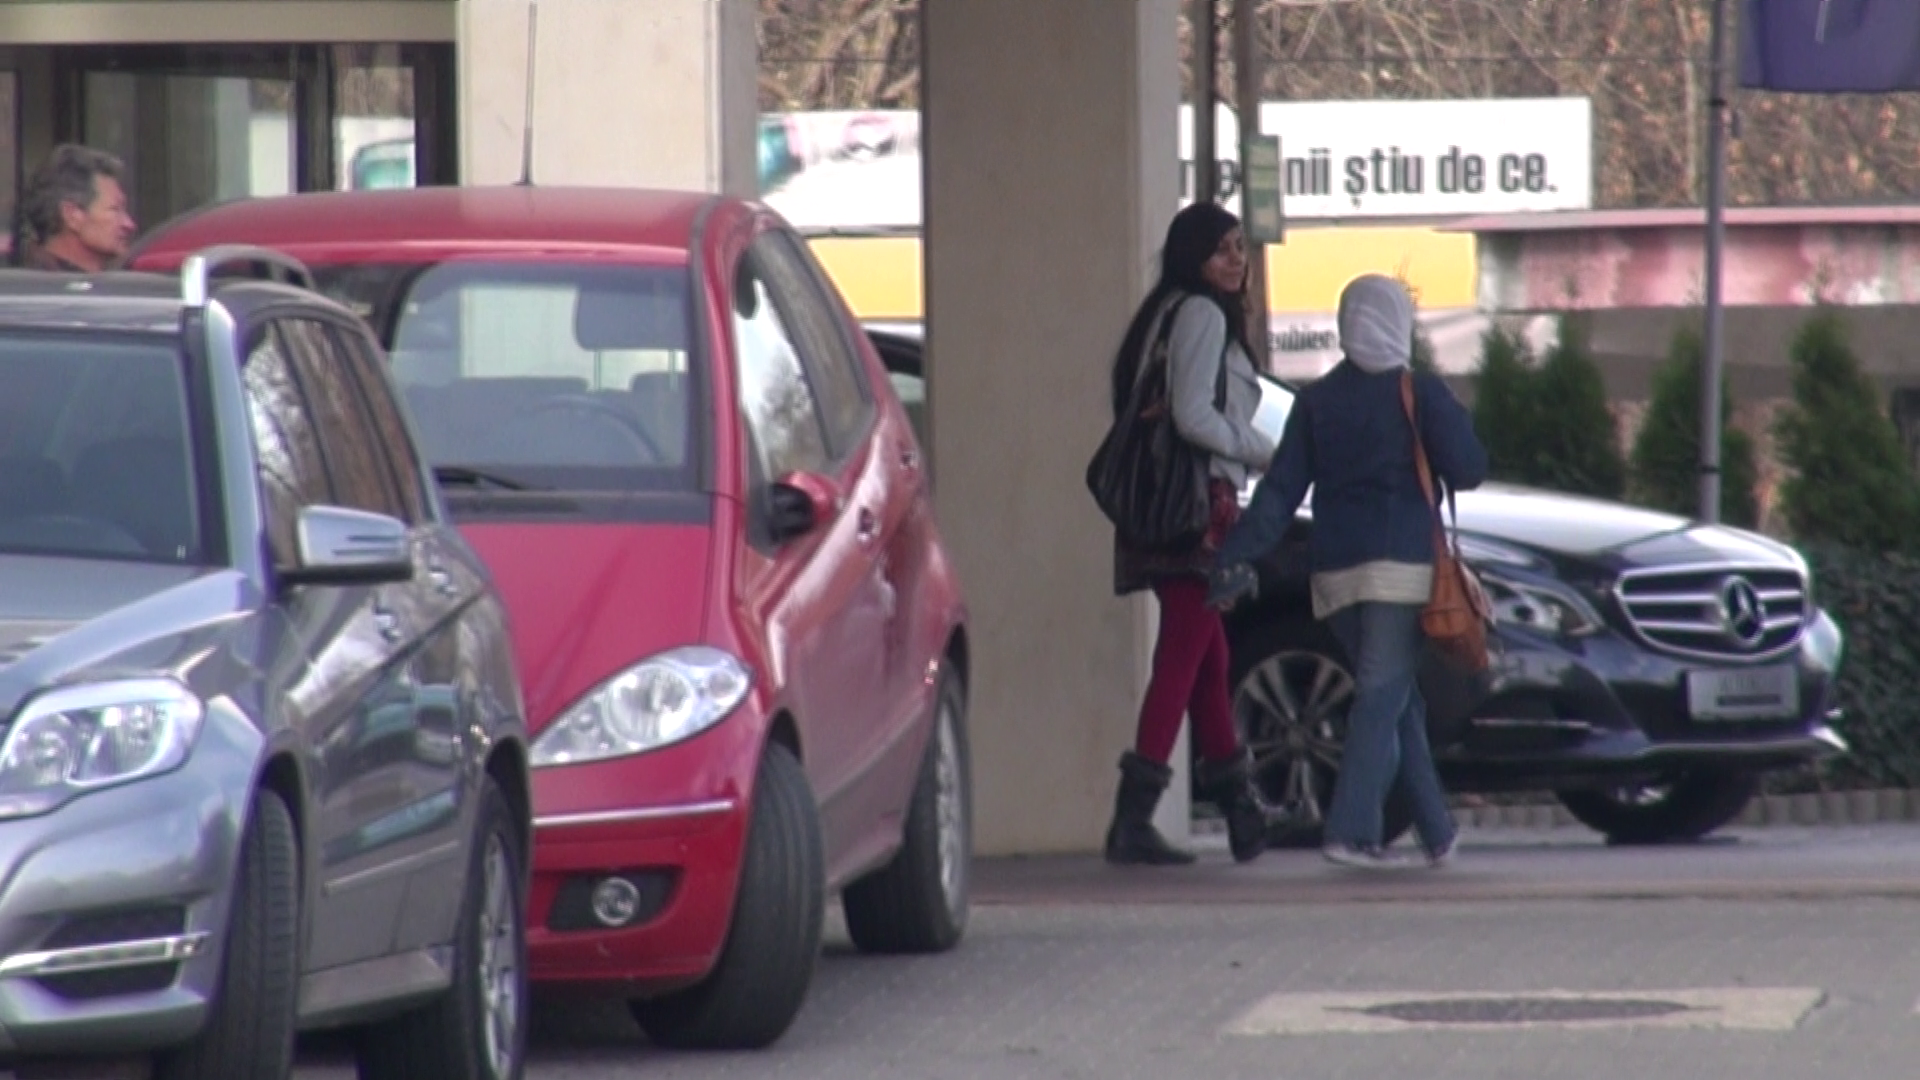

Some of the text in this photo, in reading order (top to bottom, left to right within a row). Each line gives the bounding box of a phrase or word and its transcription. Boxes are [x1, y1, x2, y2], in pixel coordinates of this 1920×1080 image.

[1345, 146, 1424, 207] știu
[1437, 146, 1484, 194] de
[1499, 153, 1558, 193] ce.
